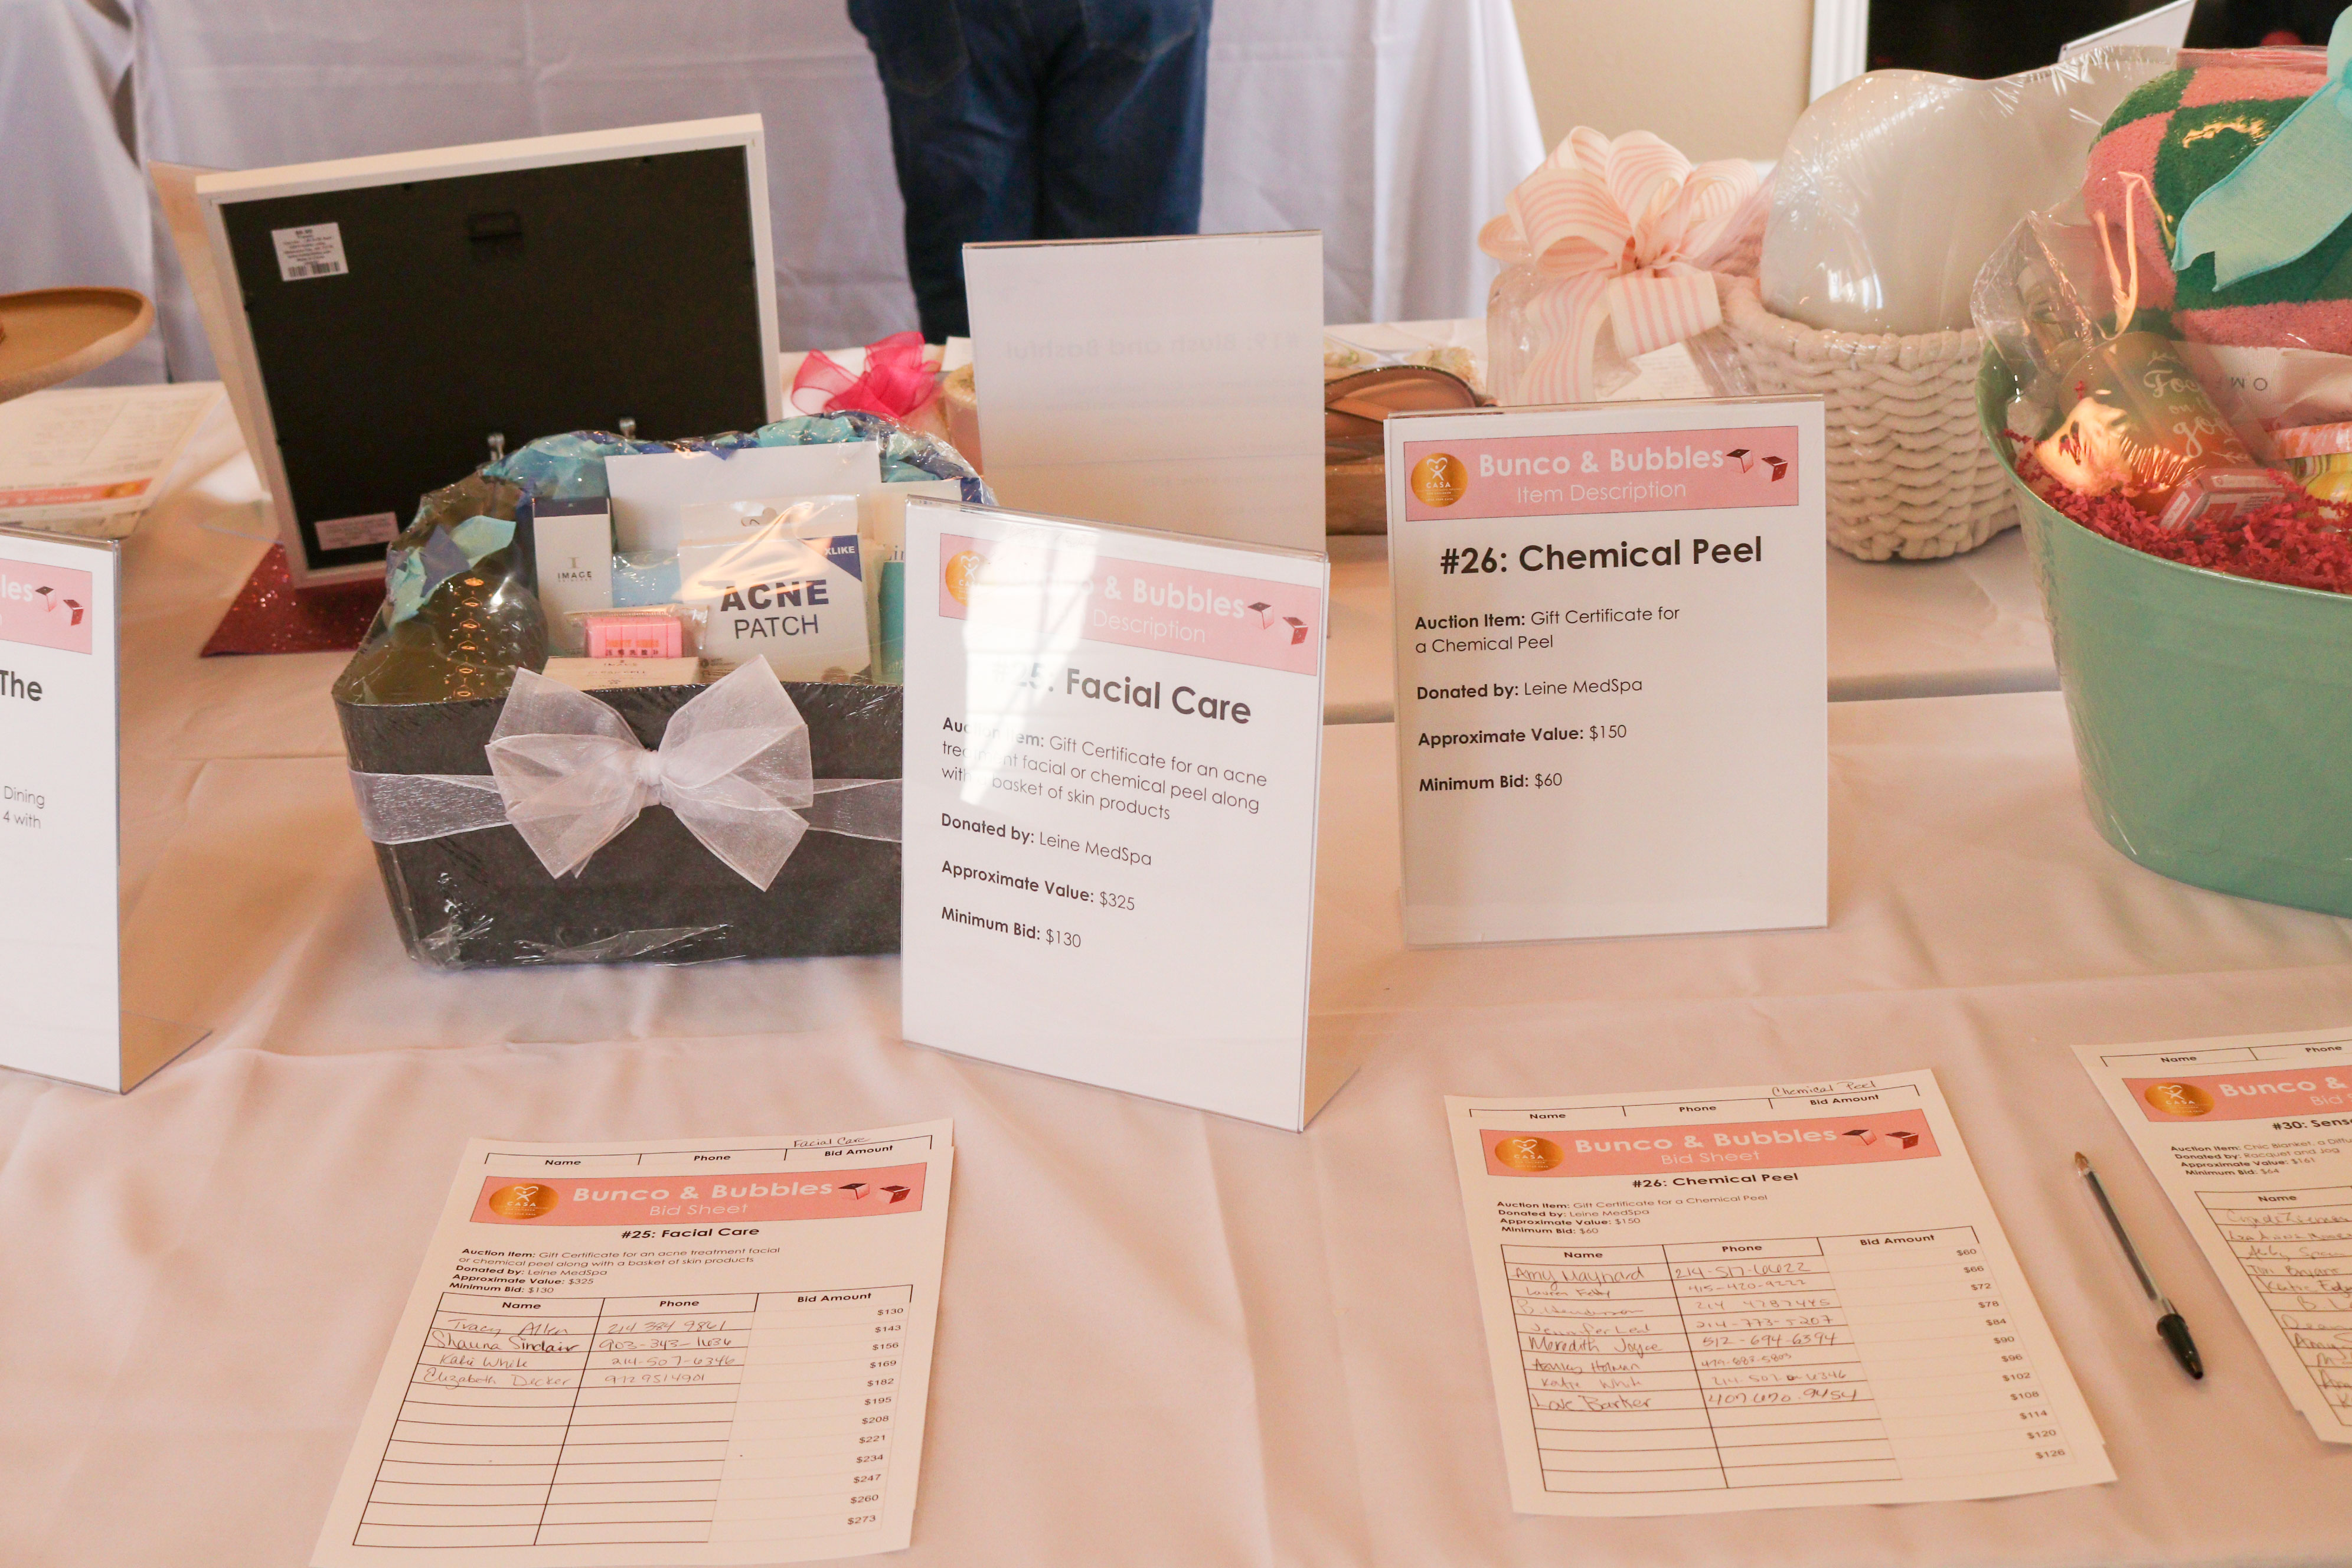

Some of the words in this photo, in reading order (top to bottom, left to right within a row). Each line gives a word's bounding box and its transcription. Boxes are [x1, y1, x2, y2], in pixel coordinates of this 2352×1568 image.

[1479, 453, 1570, 478] Bunco
[1580, 450, 1599, 473] &
[1610, 445, 1724, 472] Bubbles
[1517, 486, 1563, 504] Item
[1570, 481, 1686, 503] Description
[1440, 547, 1507, 575] #26:
[1519, 539, 1680, 571] Chemical
[1693, 535, 1762, 564] Peel
[558, 571, 592, 579] IMAGE
[720, 579, 829, 612] ACNE
[1103, 575, 1122, 600] &
[1132, 577, 1244, 620] Bubbles
[734, 613, 819, 639] PATCH
[1093, 609, 1206, 643] Description
[1415, 615, 1479, 630] Auction
[1484, 613, 1525, 627] Item:
[1531, 610, 1560, 626] Gift
[1565, 607, 1652, 624] Certificate
[1658, 606, 1680, 620] for
[1415, 642, 1426, 654] a
[1432, 636, 1513, 653] Chemical
[1518, 634, 1553, 649] Peel
[0, 669, 43, 702] The
[1417, 684, 1488, 700] Donated
[1493, 683, 1518, 700] by:
[1524, 681, 1567, 695] Leine
[1573, 678, 1642, 695] MedSpa
[1067, 668, 1161, 710] Facial
[1171, 686, 1251, 724] Care
[1417, 729, 1526, 749] Approximate
[1531, 727, 1583, 741] Value:
[1589, 724, 1627, 741] $150
[1050, 736, 1077, 753] Gift
[1082, 741, 1166, 769] Certificate
[1171, 756, 1193, 773] for
[1197, 765, 1218, 778] an
[1223, 769, 1267, 787] acne
[1023, 755, 1066, 776] facial
[1070, 767, 1086, 779] or
[1090, 769, 1165, 794] chemical
[1170, 785, 1207, 801] peel
[1211, 791, 1259, 815] along
[1419, 777, 1494, 792] Minimum
[1500, 774, 1528, 788] Bid:
[1534, 772, 1563, 789] $60
[4, 785, 45, 809] Dining
[992, 778, 1043, 796] basket
[1047, 785, 1063, 800] of
[1067, 789, 1095, 806] skin
[1099, 797, 1170, 820] products
[2, 811, 10, 822] 4
[14, 813, 41, 828] with
[942, 812, 1006, 838] Donated
[1011, 825, 1034, 845] by:
[1040, 831, 1080, 852] Leine
[1085, 841, 1152, 865] MedSpa
[942, 860, 1039, 892] Approximate
[1044, 880, 1094, 903] Value:
[1099, 891, 1135, 911] $325
[941, 906, 1008, 933] Minimum
[1014, 922, 1040, 940] Bid:
[1046, 928, 1082, 948] $130
[1771, 1085, 1835, 1097] Chemical
[1837, 1081, 1877, 1091] Peel
[2219, 1081, 2317, 1097] Bunco
[2327, 1076, 2347, 1089] &
[1832, 1094, 1879, 1104] Amount
[2272, 1121, 2308, 1131] #30:
[793, 1139, 832, 1148] Facial
[837, 1137, 871, 1145] Care
[1575, 1139, 1673, 1153] Bunco
[1684, 1135, 1704, 1148] &
[1713, 1129, 1837, 1146] Bubbles
[846, 1144, 893, 1155] Amount
[1661, 1154, 1693, 1165] Bid
[1699, 1150, 1760, 1163] Sheet
[1632, 1179, 1667, 1188] #26:
[1672, 1174, 1757, 1186] Chemical
[1761, 1172, 1798, 1182] Peel
[573, 1188, 669, 1201] Bunco
[680, 1186, 699, 1200] &
[711, 1181, 832, 1198] Bubbles
[1685, 1195, 1741, 1204] Chemical
[649, 1205, 681, 1216] Bid
[689, 1203, 749, 1216] Sheet
[1615, 1217, 1641, 1226] $150
[622, 1230, 656, 1239] #25:
[661, 1228, 713, 1238] Facial
[718, 1228, 760, 1236] Care
[1884, 1234, 1935, 1244] Amount
[462, 1248, 505, 1256] Auction
[472, 1258, 525, 1266] chemical
[704, 1256, 754, 1265] products
[456, 1265, 504, 1274] Donated
[449, 1282, 502, 1292] Minimum
[452, 1274, 526, 1285] Approximate
[1971, 1283, 1991, 1291] $72
[821, 1292, 871, 1302] Amount
[877, 1308, 904, 1316] $130
[875, 1325, 901, 1334] $143
[870, 1360, 897, 1369] $169
[2002, 1372, 2031, 1382] $102
[2019, 1410, 2047, 1420] $114
[853, 1474, 881, 1484] $247
[847, 1515, 876, 1525] $273
